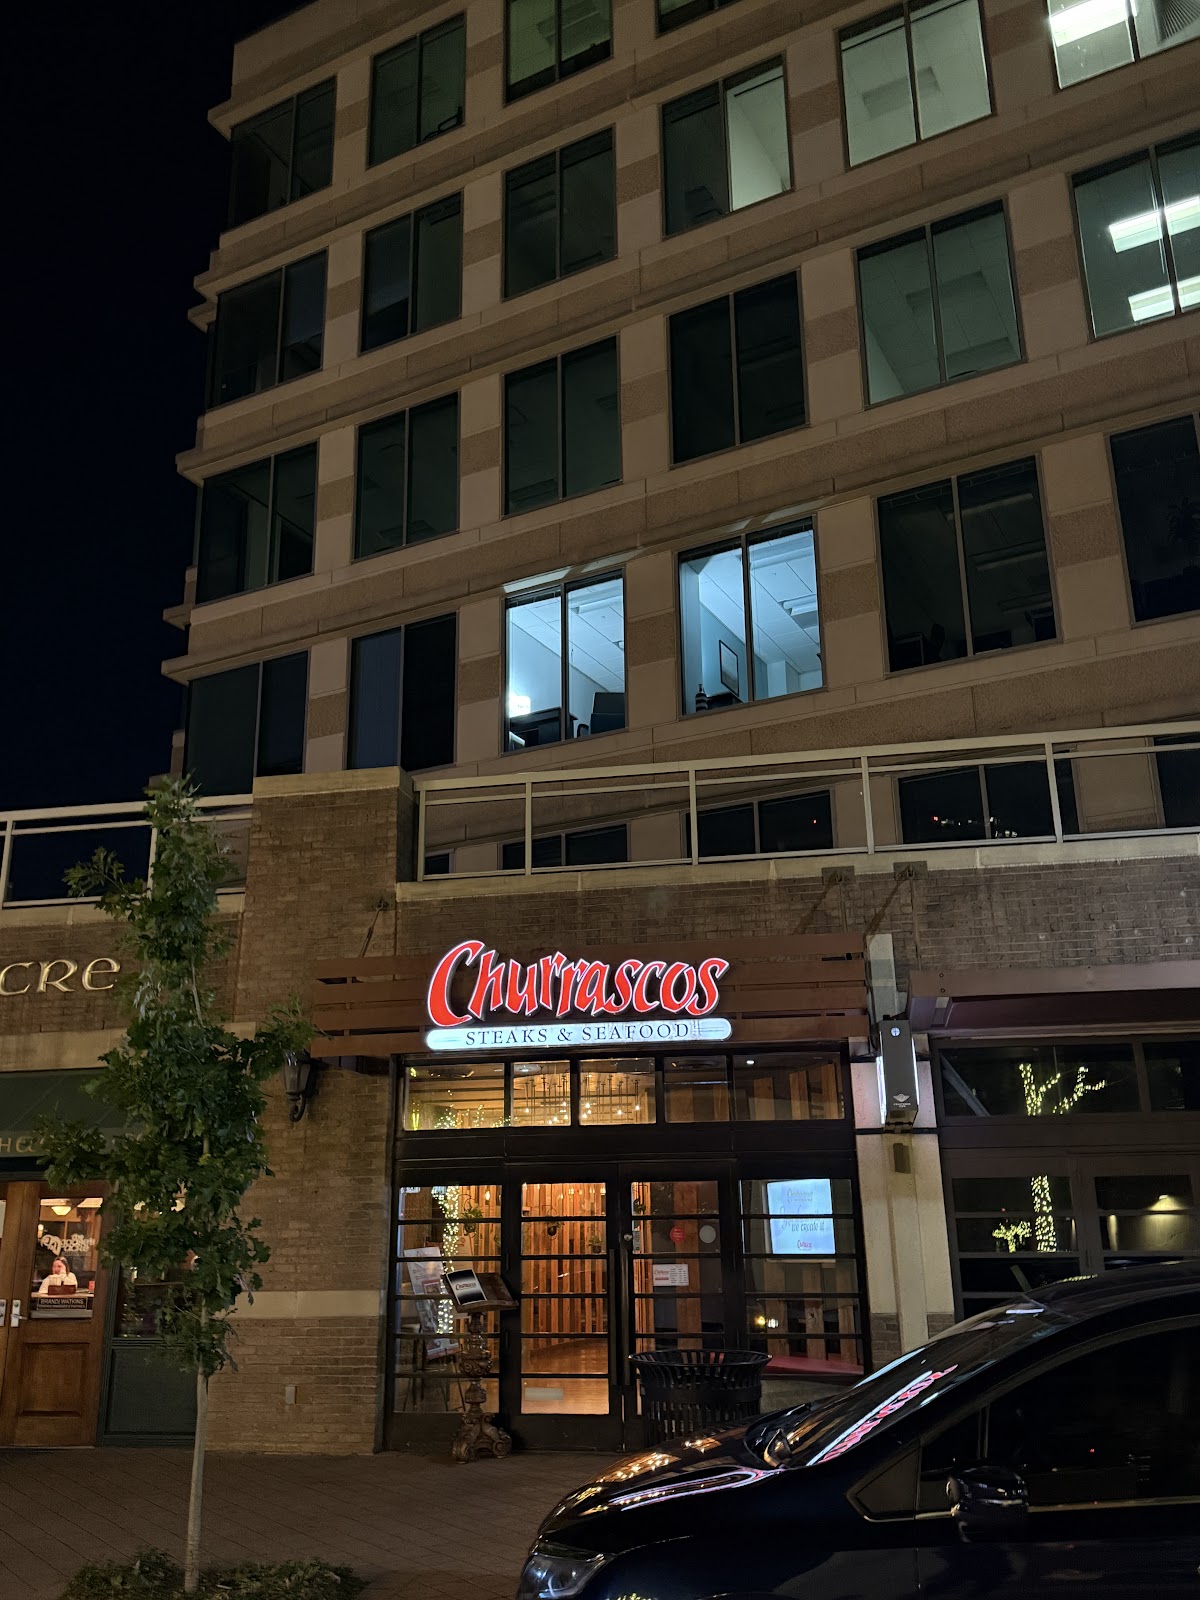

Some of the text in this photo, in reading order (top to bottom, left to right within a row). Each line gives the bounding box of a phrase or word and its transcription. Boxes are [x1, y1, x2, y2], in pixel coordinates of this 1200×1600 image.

[427, 940, 730, 1026] Churrascos
[465, 1023, 690, 1046] STEAKS & SEAFOOD
